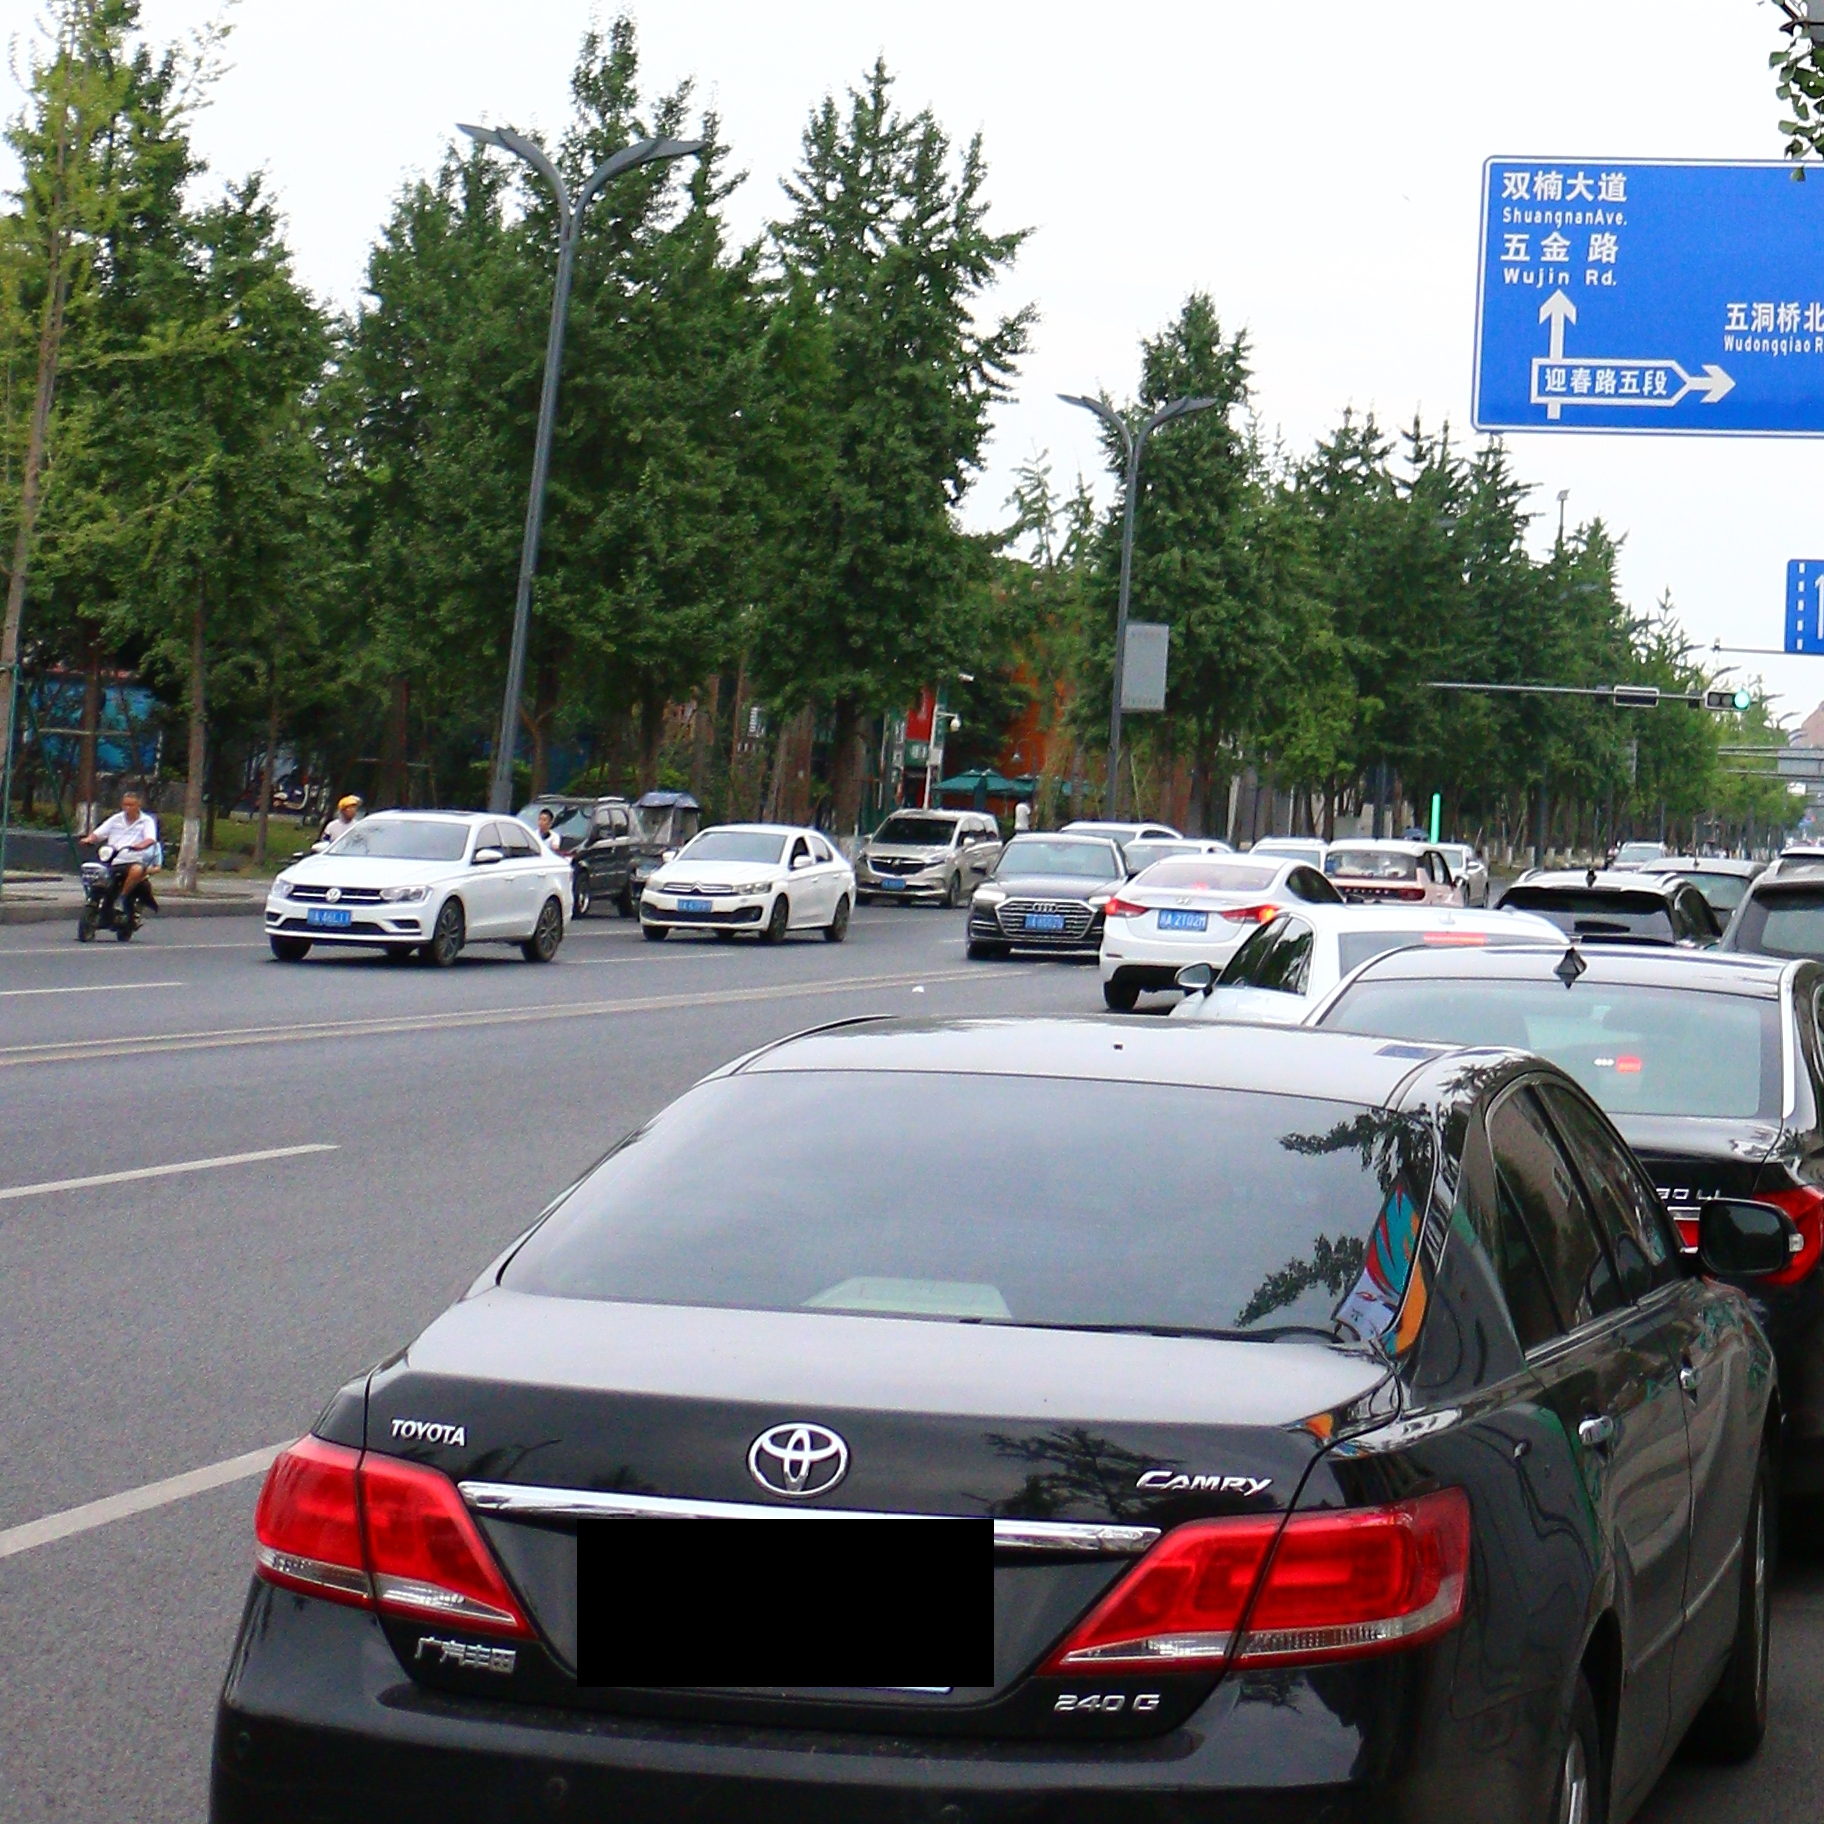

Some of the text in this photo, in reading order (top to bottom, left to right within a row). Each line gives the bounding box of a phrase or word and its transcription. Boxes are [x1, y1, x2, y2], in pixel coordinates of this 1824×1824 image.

[1501, 171, 1627, 202] 双楠大道
[1500, 231, 1619, 264] 五金路
[1503, 267, 1617, 288] Wujin Rd.
[1724, 335, 1811, 357] Wudongqiao
[1544, 367, 1668, 396] 迎春路五段
[391, 1418, 467, 1447] TOYOTA
[1136, 1470, 1273, 1497] CAMRY
[415, 1637, 516, 1674] 广汽丰田
[1054, 1694, 1161, 1712] 240 G
